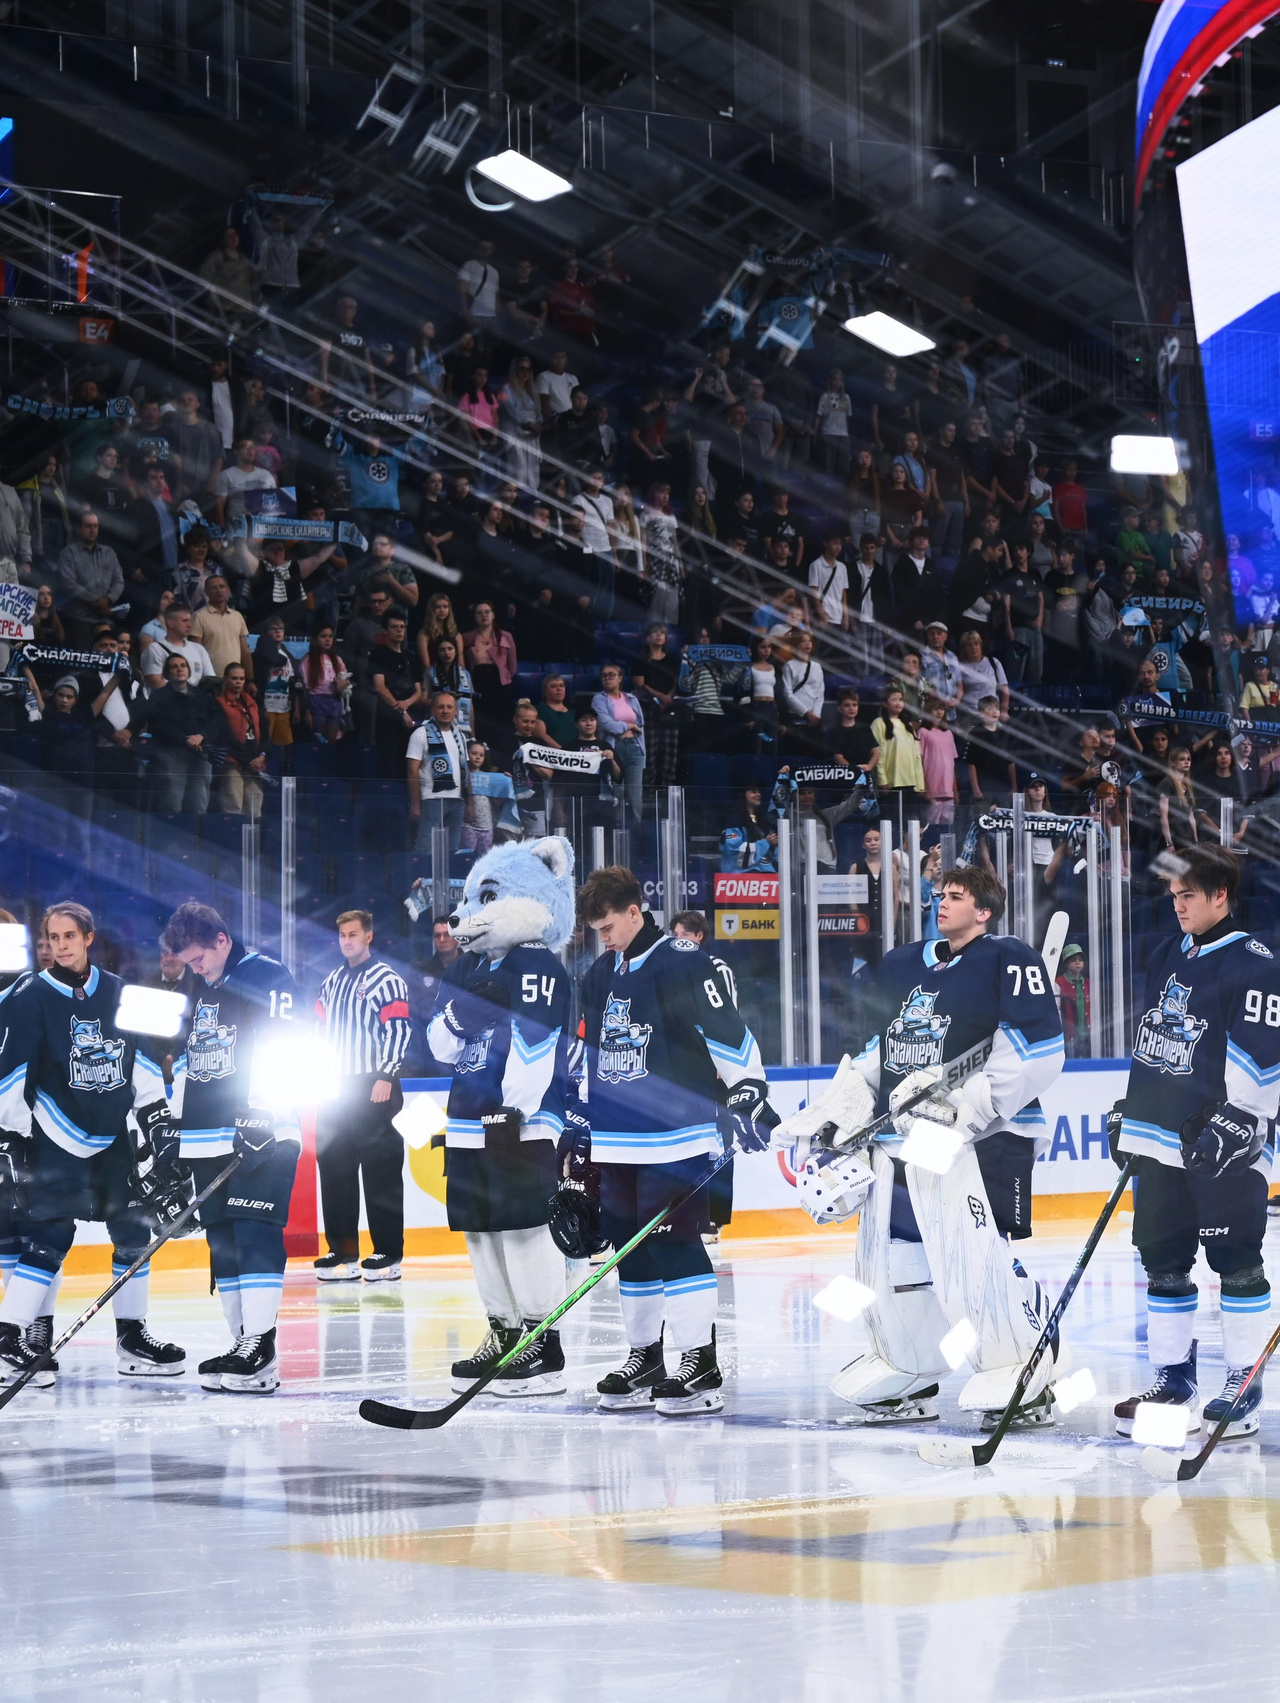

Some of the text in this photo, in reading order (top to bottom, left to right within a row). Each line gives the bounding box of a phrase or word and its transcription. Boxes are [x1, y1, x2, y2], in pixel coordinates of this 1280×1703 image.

[85, 322, 109, 339] E4
[7, 394, 100, 419] СИБИРЬ
[255, 524, 332, 538] СИБИРСКИЕ СНАЙПЕРЫ
[1129, 596, 1206, 613] СИБИРЬ
[23, 643, 112, 665] СНАЙПЕРЫ
[692, 649, 743, 660] СИБИРЬ
[1135, 703, 1176, 717] СИБИРЬ
[529, 749, 591, 769] СИБИРЬ
[795, 768, 855, 782] СИБИРЬ
[643, 880, 698, 896] СОЗ
[715, 879, 780, 897] FONBET
[741, 919, 775, 930] БАНК
[1007, 965, 1046, 996] 78
[522, 974, 556, 1006] 54
[269, 990, 293, 1020] 12
[444, 999, 464, 1031] PRIM
[727, 1092, 750, 1108] UER
[148, 1108, 170, 1123] CC
[235, 1118, 270, 1128] AUER
[481, 1114, 507, 1125] RIME
[1211, 1113, 1249, 1140] AUER
[1037, 1113, 1109, 1162] АН
[850, 1176, 871, 1188] BAUER
[227, 1197, 275, 1211] BAUER
[649, 1224, 673, 1234] CM
[1199, 1226, 1229, 1236] CCM
